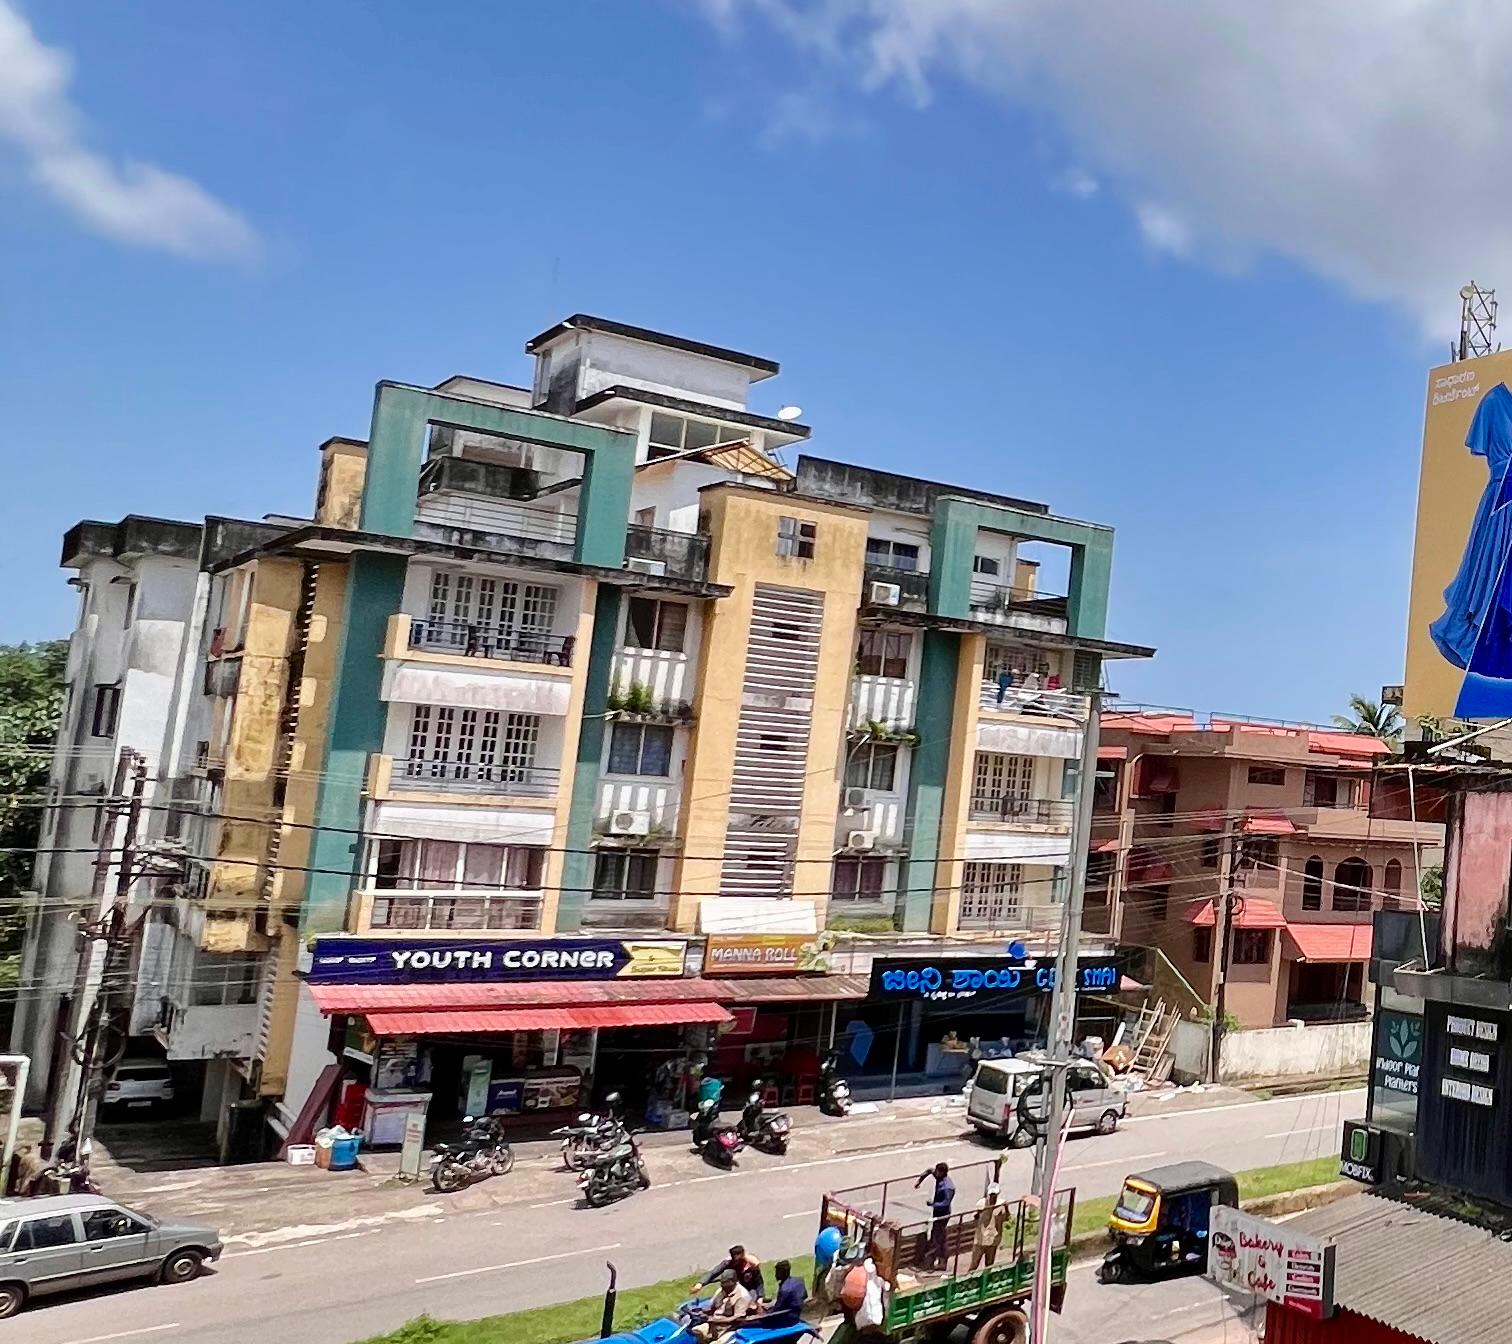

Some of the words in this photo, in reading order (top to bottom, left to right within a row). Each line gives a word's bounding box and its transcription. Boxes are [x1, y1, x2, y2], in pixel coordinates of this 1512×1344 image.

[391, 950, 493, 969] YOUTH
[765, 947, 798, 961] ROLL
[1239, 1231, 1284, 1258] Bakery
